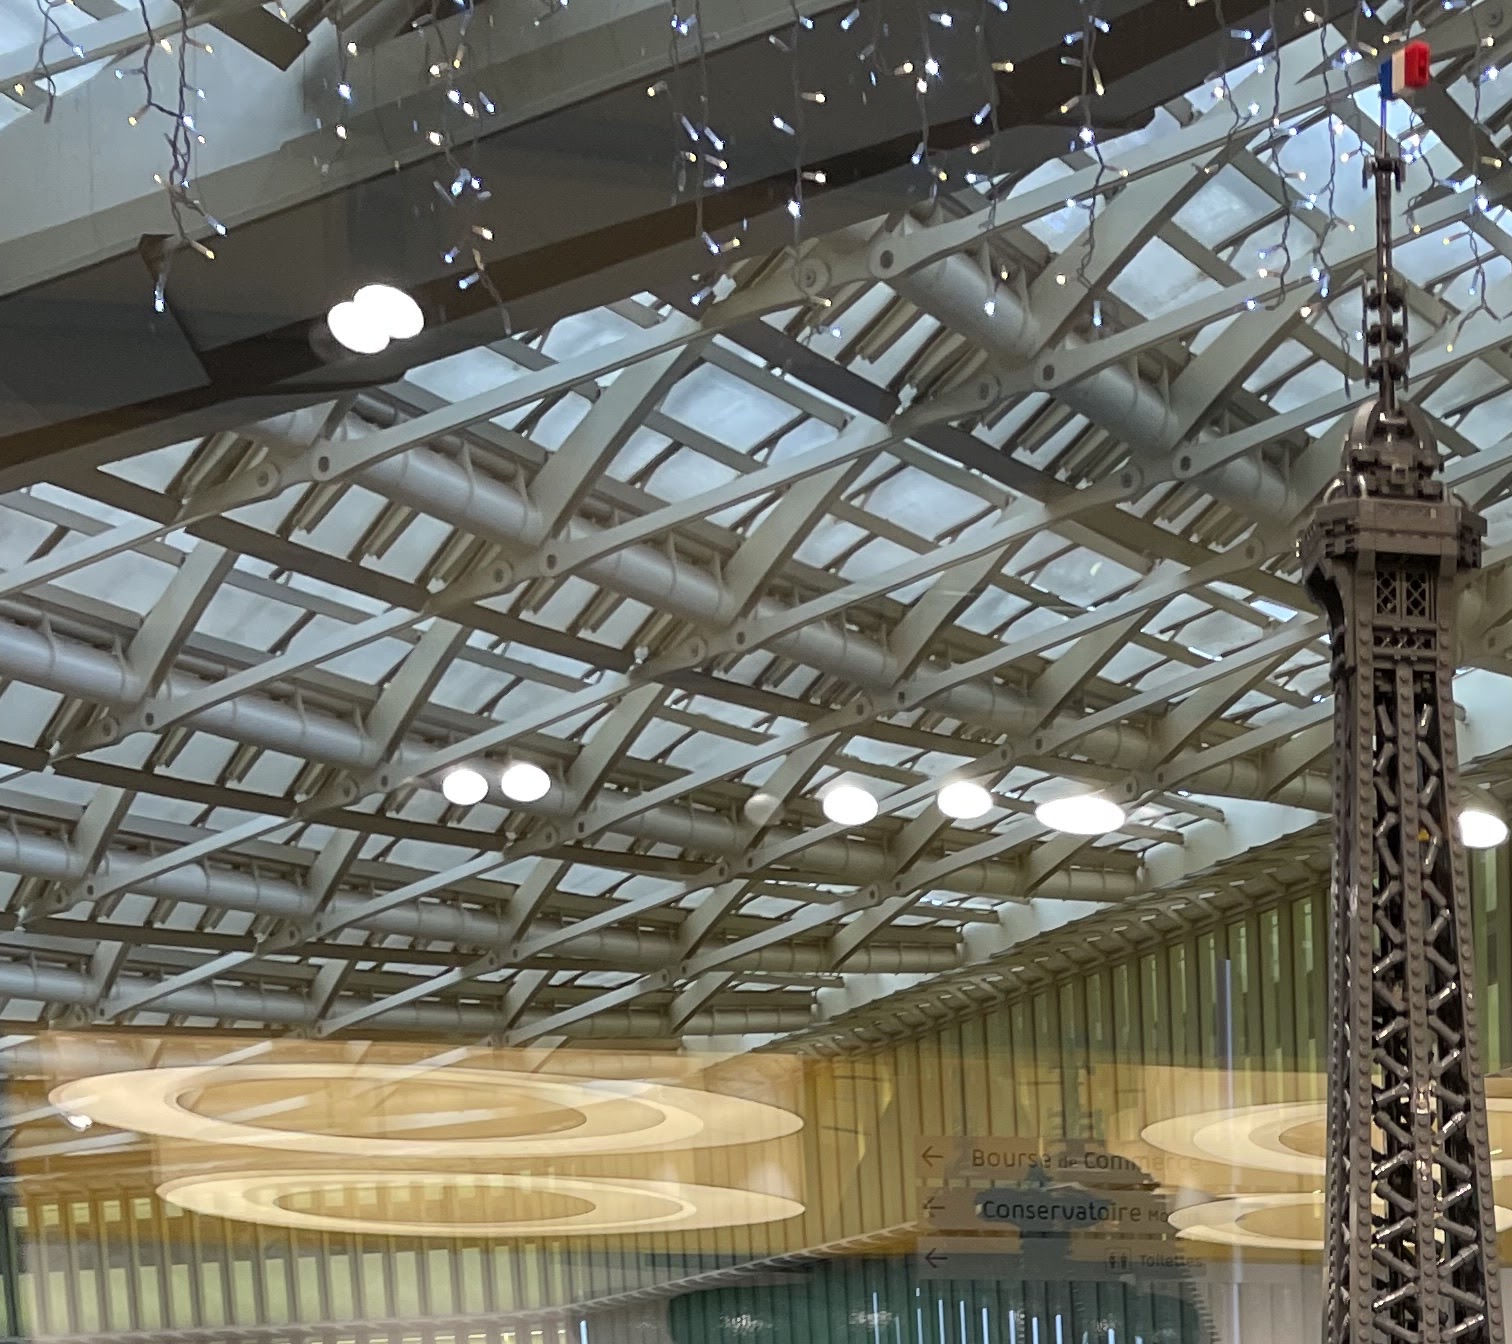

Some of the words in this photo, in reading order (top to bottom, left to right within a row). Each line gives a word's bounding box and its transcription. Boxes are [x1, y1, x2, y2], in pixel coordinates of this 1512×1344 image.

[971, 1148, 1052, 1170] Bourse
[1058, 1153, 1078, 1169] de
[981, 1200, 1142, 1222] Conservatoire
[1139, 1253, 1204, 1269] Toilettes
